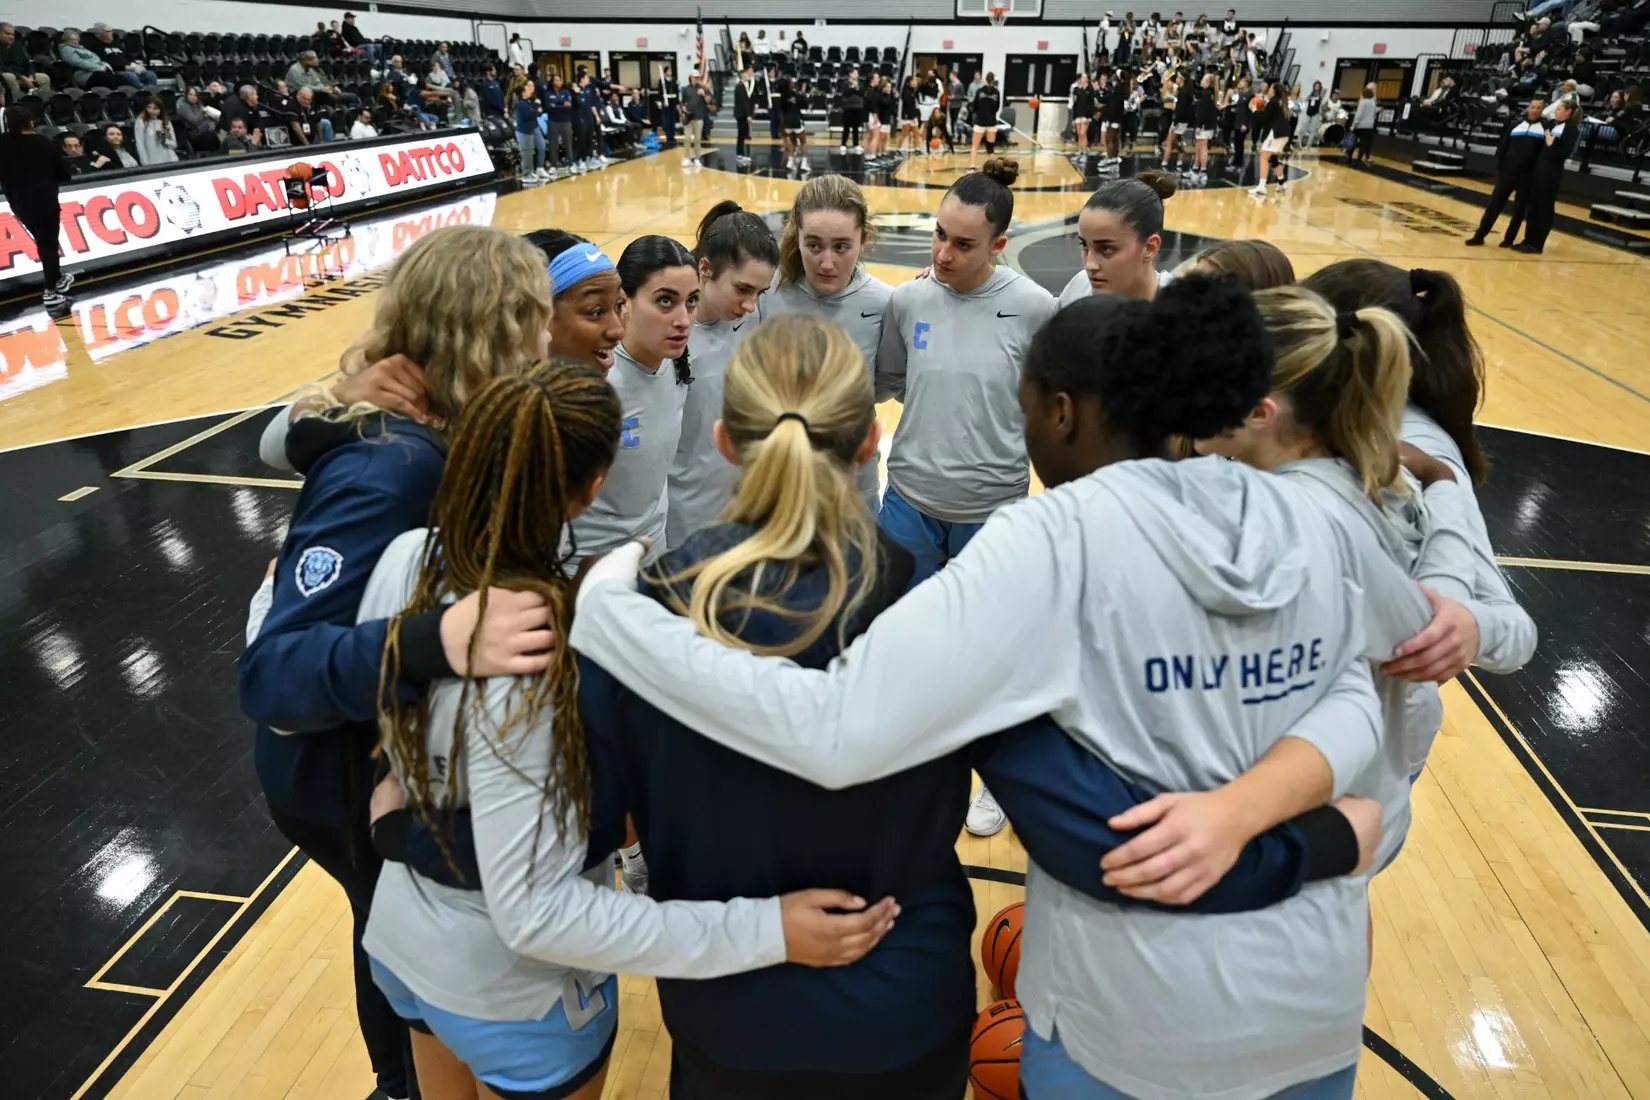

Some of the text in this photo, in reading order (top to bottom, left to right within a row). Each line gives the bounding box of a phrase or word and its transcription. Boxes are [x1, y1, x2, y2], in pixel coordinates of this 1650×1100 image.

[377, 142, 465, 187] DATTCO
[913, 321, 931, 350] C
[1144, 654, 1229, 692] ONLY
